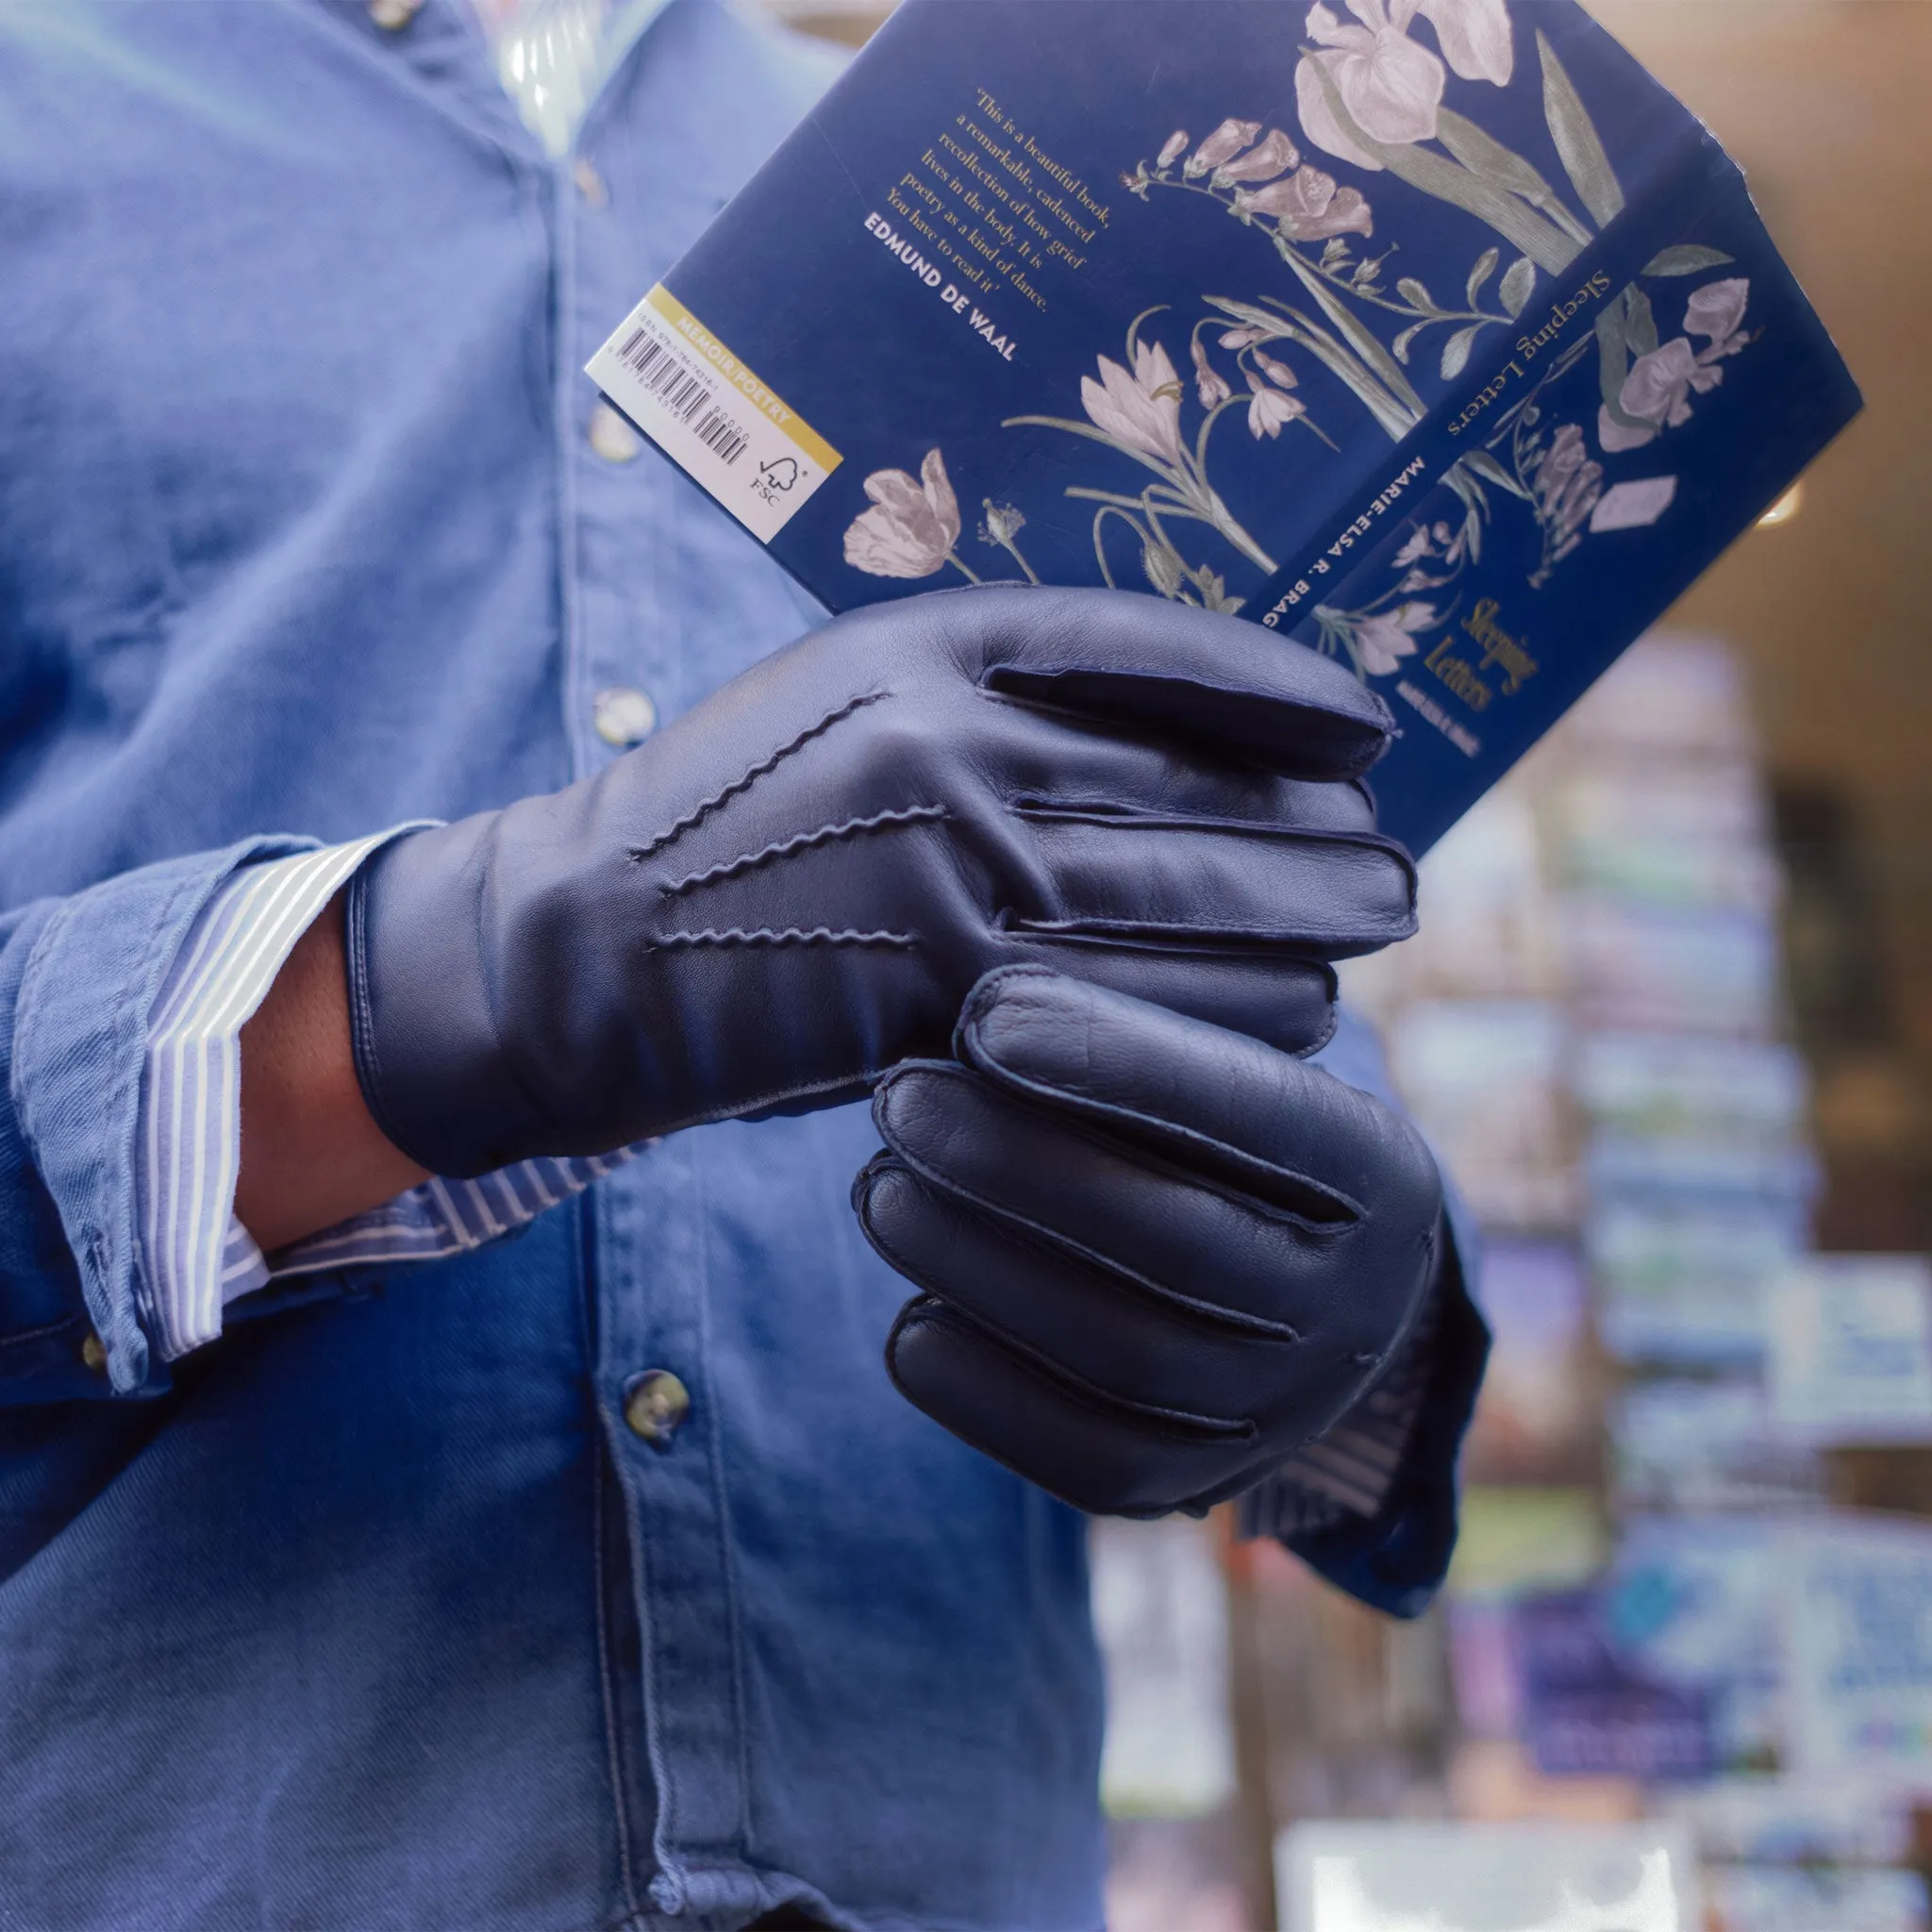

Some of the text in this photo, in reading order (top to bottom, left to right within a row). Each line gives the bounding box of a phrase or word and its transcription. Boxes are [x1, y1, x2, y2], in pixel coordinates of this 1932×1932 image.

[921, 148, 1042, 269] lives in the body. It is
[938, 133, 1088, 270] recollection of how grief
[956, 115, 1096, 243] a remarkable, cadenced
[1002, 118, 1016, 135] is
[1014, 133, 1024, 143] a
[1024, 135, 1081, 193] beautiful
[1075, 186, 1109, 229] book,
[863, 211, 1016, 361] EDMUND DE WAAL
[887, 186, 910, 216] You
[908, 208, 938, 241] have
[937, 239, 953, 256] to
[952, 254, 985, 283] read
[899, 173, 1046, 313] poetry as a kind of dance.
[675, 318, 794, 425] MEMOIR/POETRY
[1447, 269, 1610, 436] Sleeping Letters
[749, 477, 780, 507] FSC
[1326, 456, 1425, 557] MARIE-ELSA
[1307, 558, 1330, 575] R.
